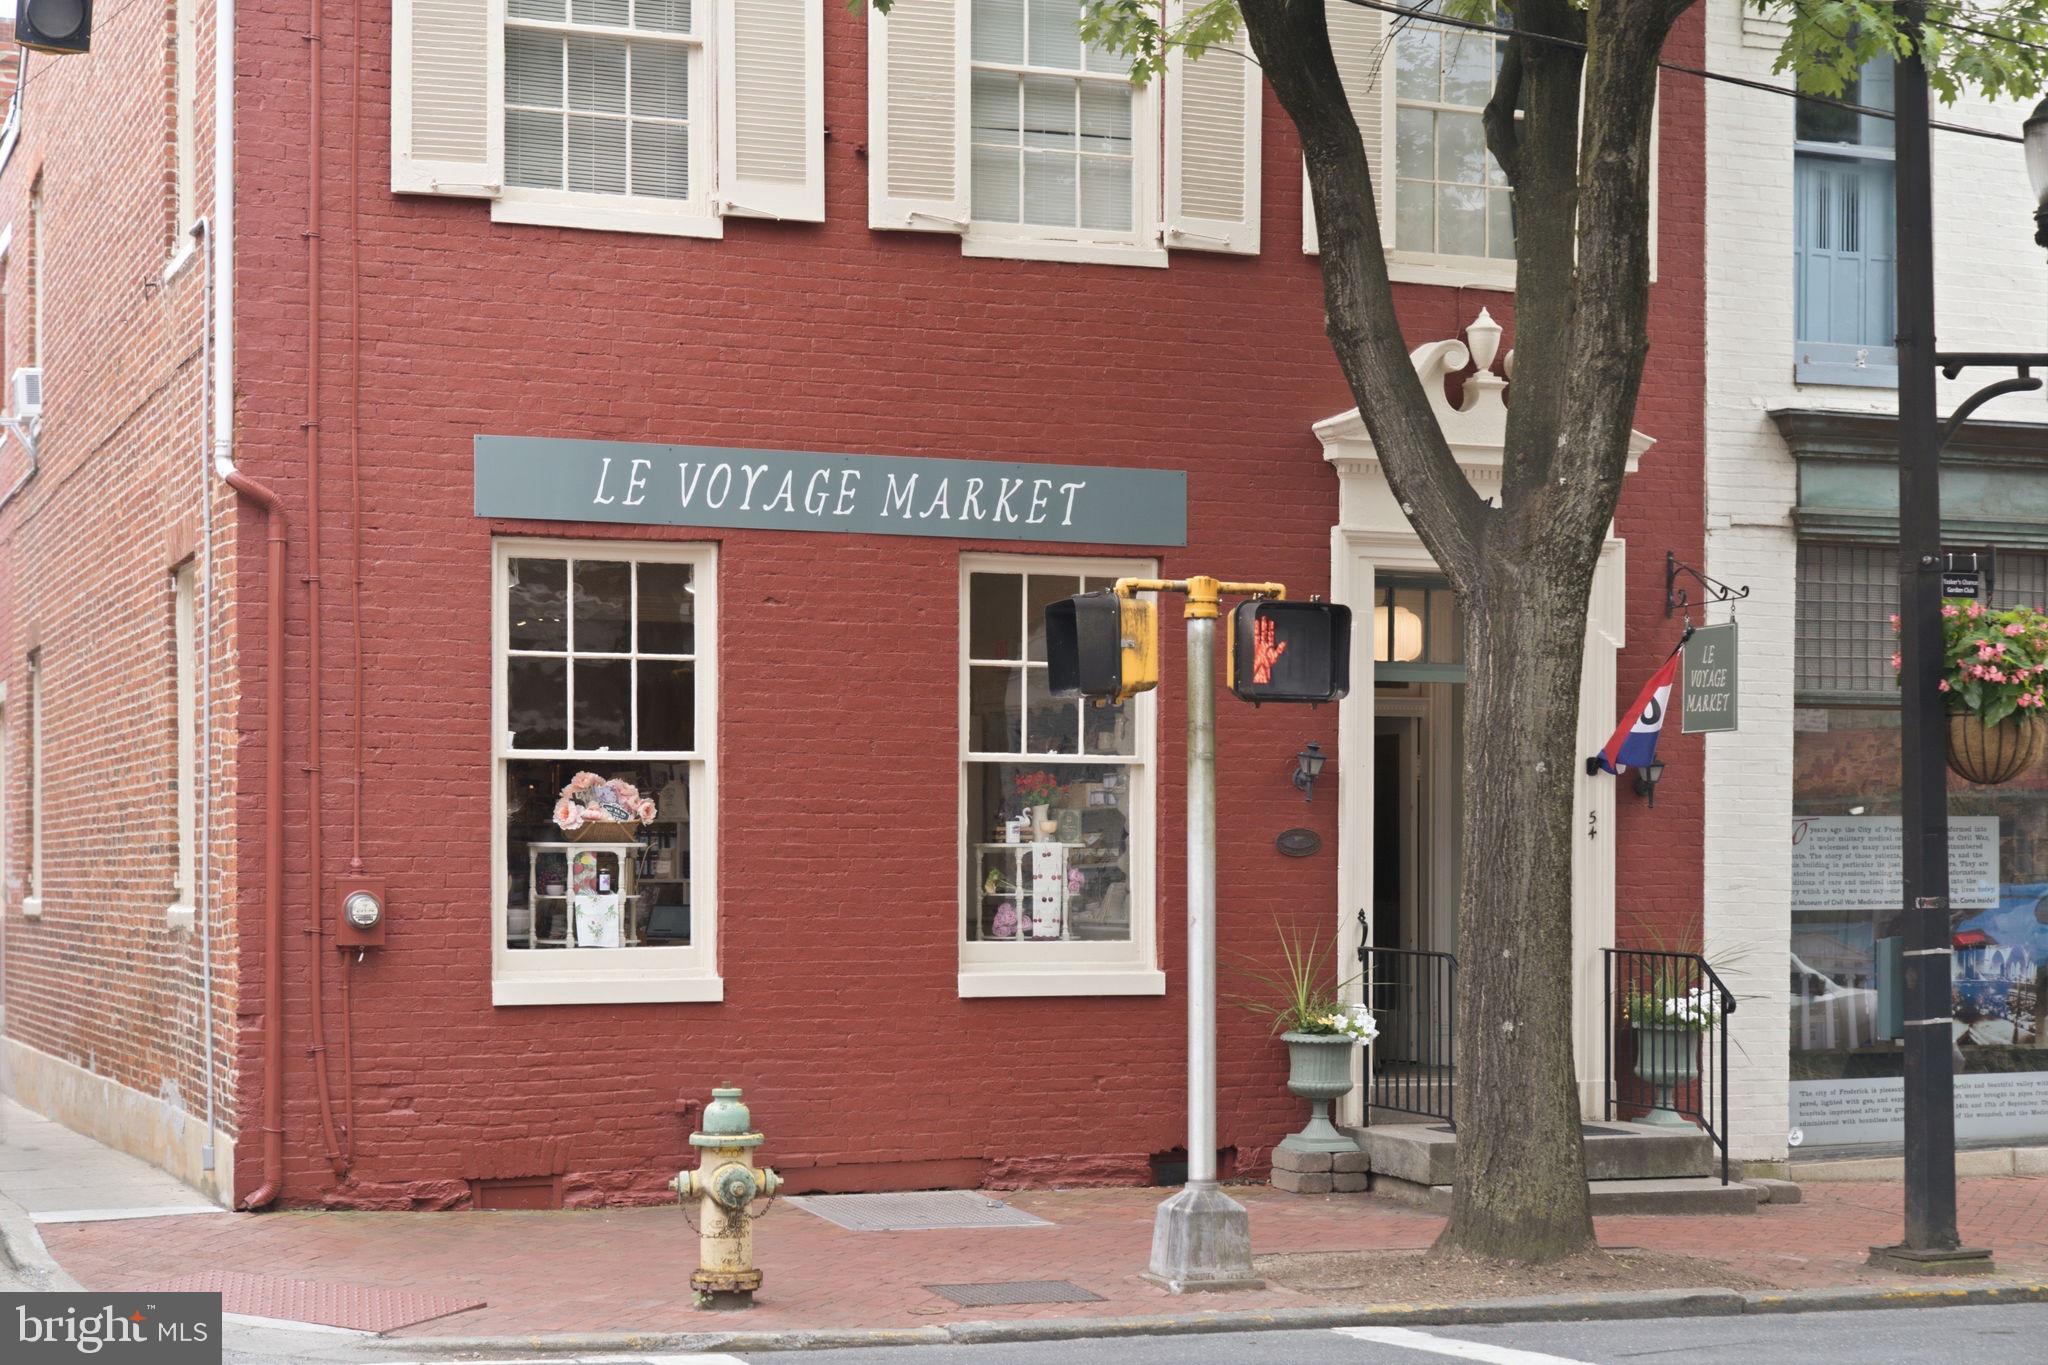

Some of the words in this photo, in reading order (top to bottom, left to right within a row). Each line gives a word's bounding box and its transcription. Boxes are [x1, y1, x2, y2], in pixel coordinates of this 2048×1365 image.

[593, 457, 651, 506] LE
[678, 462, 861, 517] VOYAGE
[879, 472, 1086, 526] MARKET
[1703, 645, 1715, 664] LE
[1691, 669, 1727, 687] VOYAGE
[1687, 693, 1730, 712] MARKET
[1839, 835, 1864, 843] military
